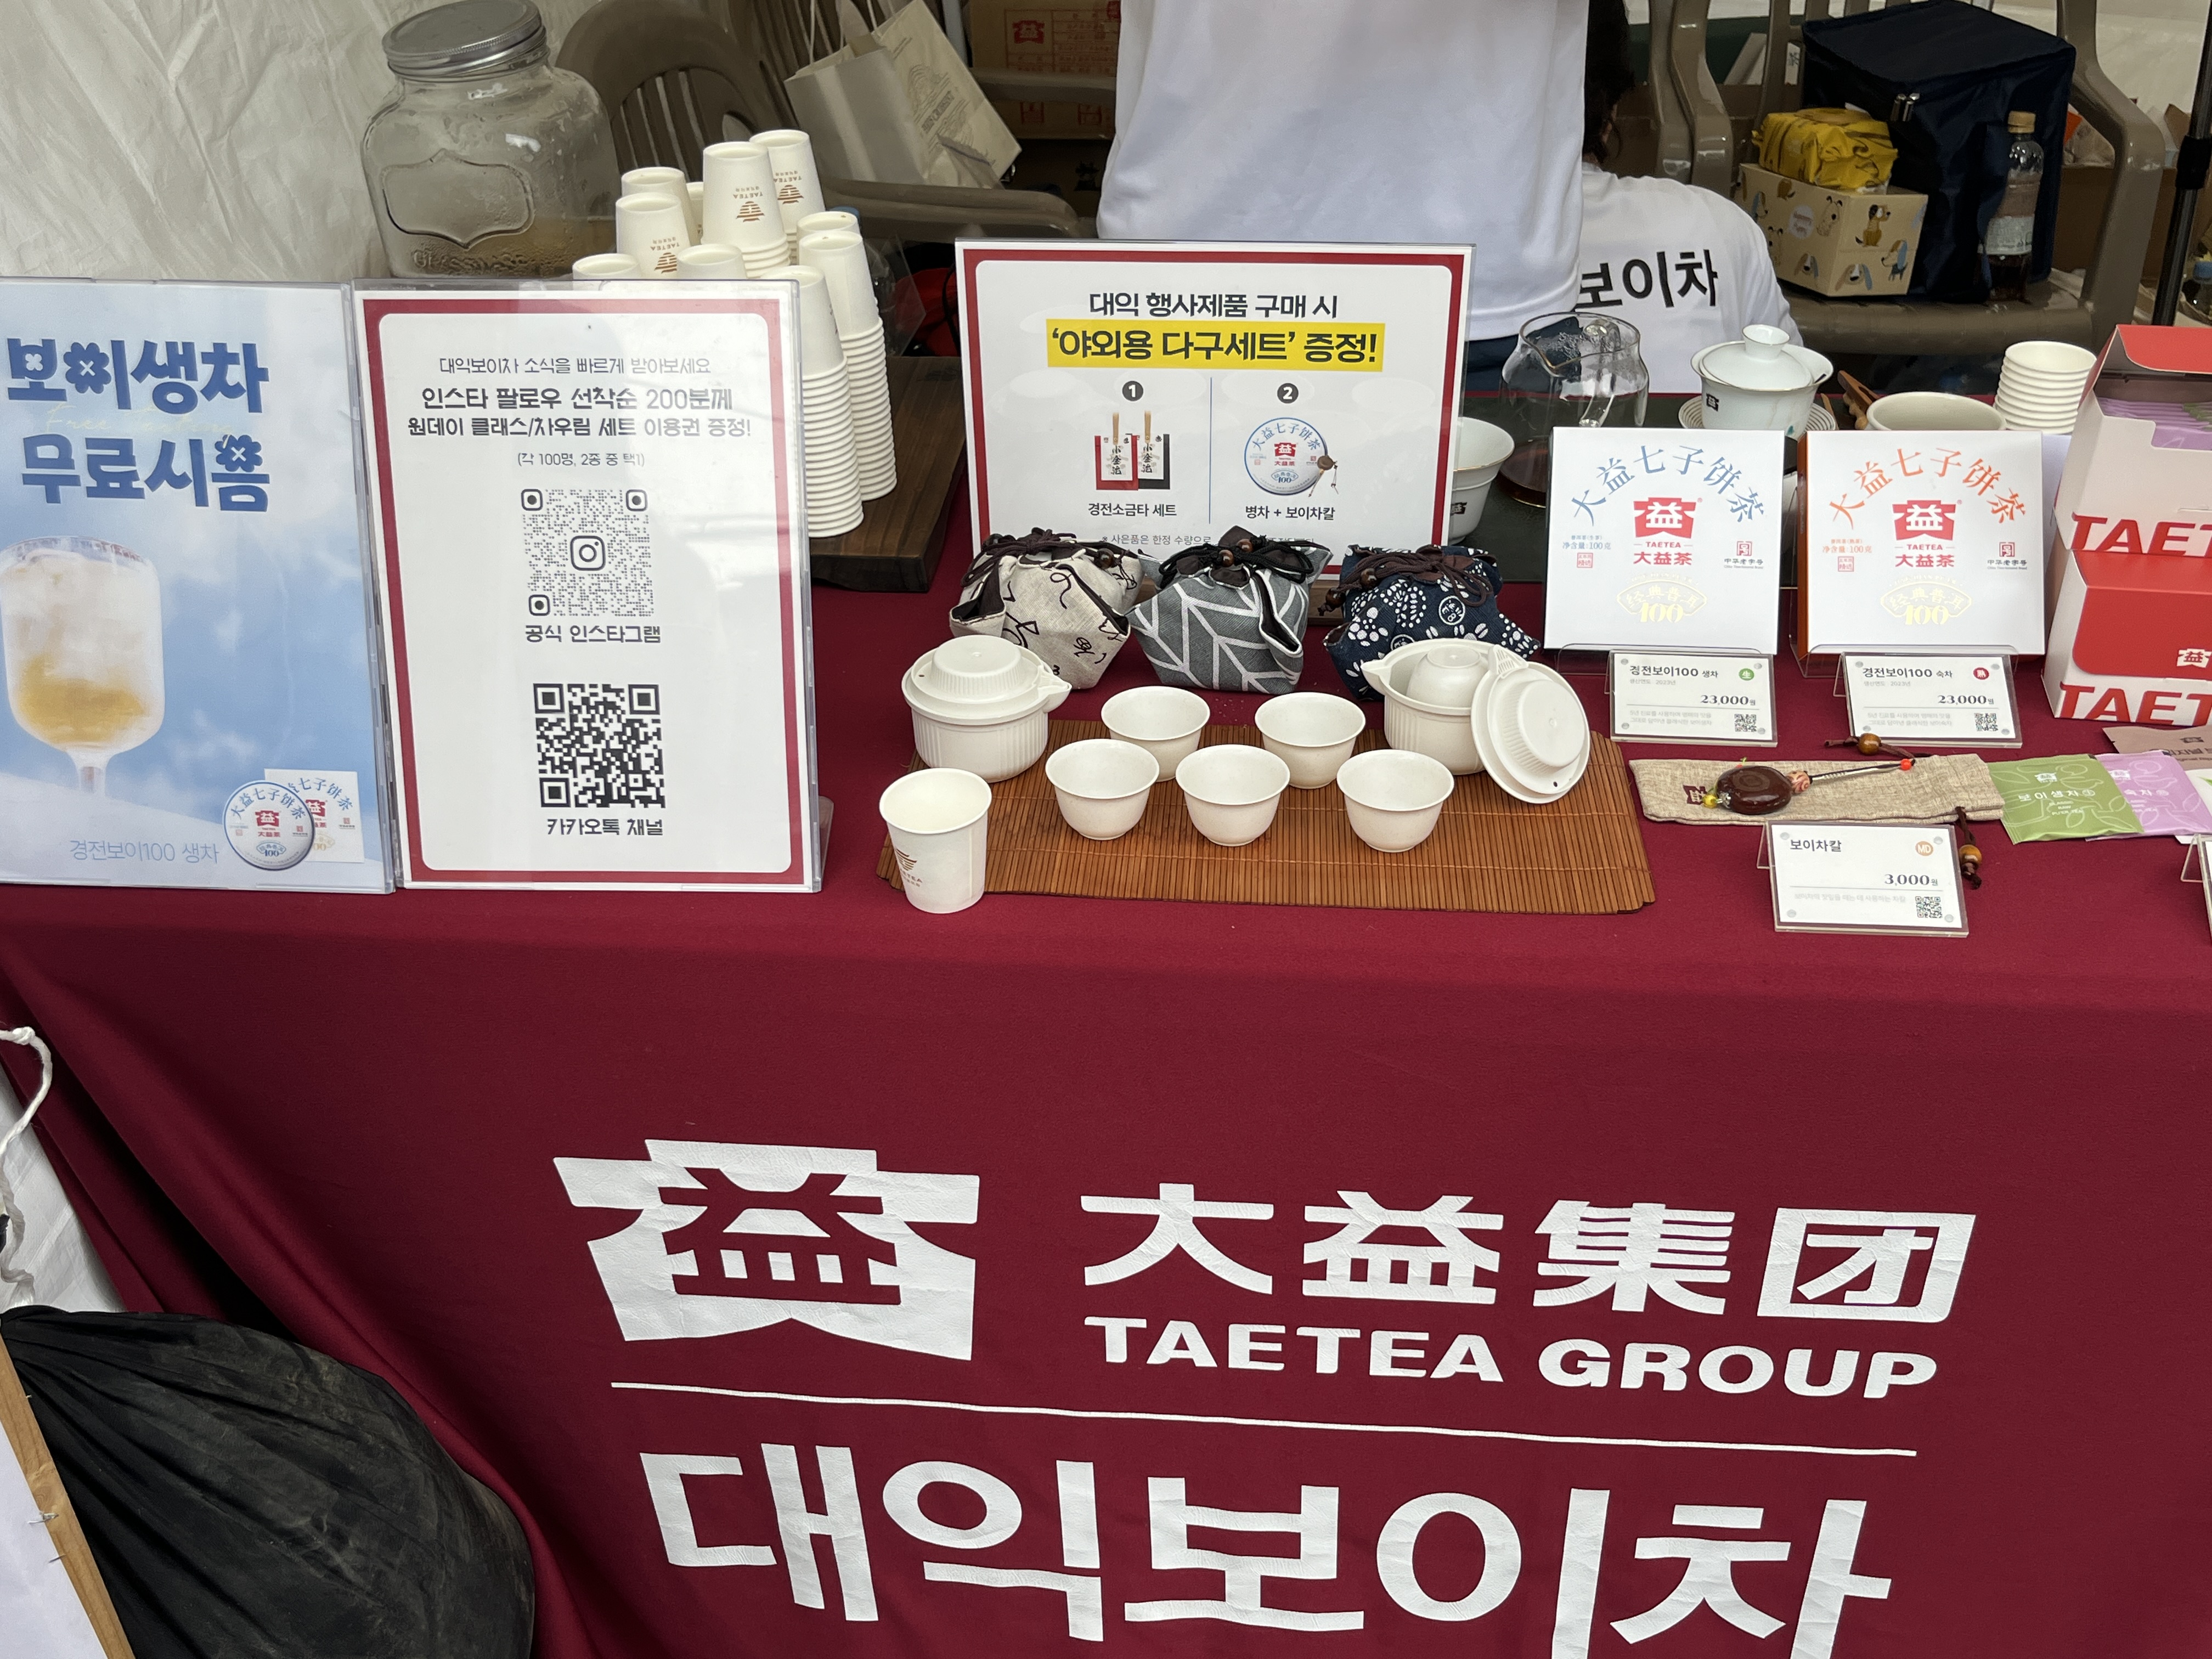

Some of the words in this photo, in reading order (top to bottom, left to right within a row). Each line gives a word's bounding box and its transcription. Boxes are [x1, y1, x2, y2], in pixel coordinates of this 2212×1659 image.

[650, 242, 680, 251] TAETEA
[1090, 292, 1138, 318] 대익
[1147, 292, 1248, 318] 행사제품
[1254, 294, 1306, 318] 구매
[1312, 295, 1338, 319] 시
[1303, 334, 1378, 363] 증정!
[7, 338, 269, 414] 보이생차
[439, 358, 519, 375] 대익보이차
[524, 358, 571, 375] 소식을
[577, 358, 625, 375] 빠르게
[630, 358, 711, 375] 받아보세요
[422, 387, 488, 409] 인스타
[496, 387, 562, 409] 팔로우
[571, 387, 637, 409] 선착순
[646, 388, 732, 410] 200분께
[408, 417, 463, 437] 원데이
[472, 417, 591, 437] 클래스/차우림
[599, 417, 636, 437] 세트
[645, 417, 700, 437] 이용권
[708, 417, 751, 437] 증정!
[518, 453, 534, 467] (각
[539, 453, 576, 467] 100명,
[581, 453, 601, 467] 2종
[606, 453, 618, 467] 중
[22, 434, 269, 512] 무료시음
[1571, 445, 1764, 526] 大益七子饼茶
[1829, 448, 2025, 529] 大益七子饼茶
[1088, 503, 1150, 517] 경전소금타
[1153, 504, 1177, 517] 세트
[1245, 506, 1271, 520] 병차
[1285, 506, 1335, 521] 보이차칼
[1111, 534, 1149, 544] 사은품은
[1153, 534, 1171, 544] 한정
[1633, 552, 1692, 566] 大益茶
[1895, 555, 1954, 567] 大益茶
[1640, 602, 1684, 623] 100
[1905, 605, 1949, 625] 100
[525, 625, 562, 642] 공식
[570, 625, 661, 643] 인스타그램
[1630, 665, 1698, 676] 경전보이100
[1863, 668, 1932, 678] 경전보이100
[548, 819, 619, 836] 카카오톡
[627, 819, 663, 836] 채널
[70, 840, 175, 863] 경전보이100
[183, 843, 219, 865] 생차
[1790, 839, 1842, 852] 보이차칼
[1918, 844, 1931, 853] MD
[1081, 1182, 1977, 1325] 大益集团
[1084, 1316, 1504, 1384] TAETEA
[1536, 1336, 1938, 1402] GROUP
[639, 1441, 1892, 1659] 대익보이차
